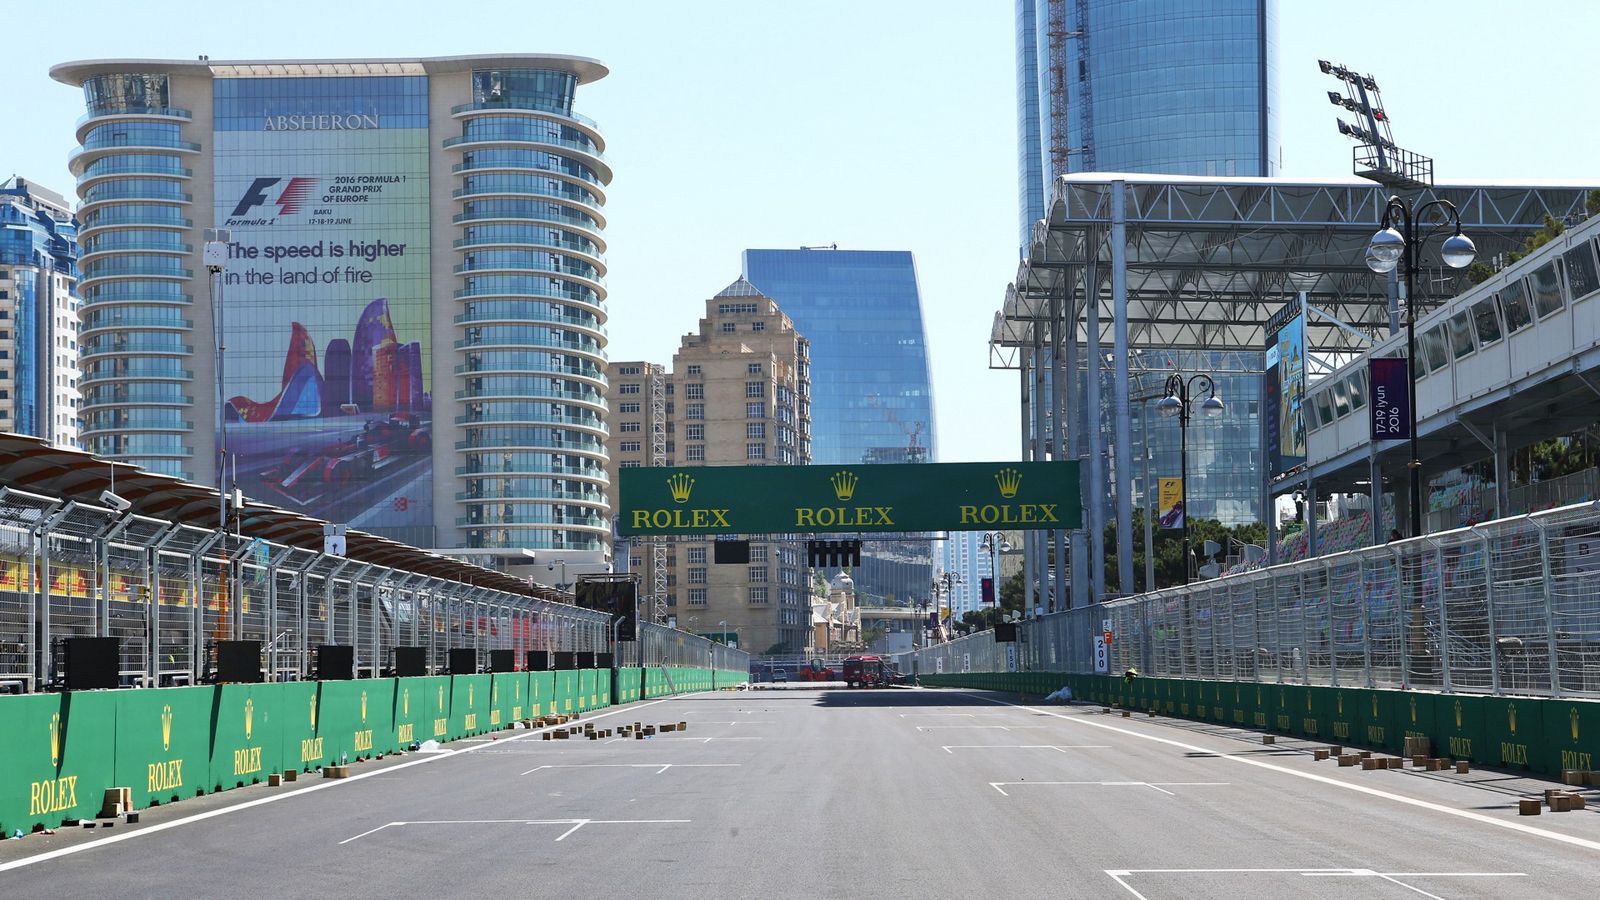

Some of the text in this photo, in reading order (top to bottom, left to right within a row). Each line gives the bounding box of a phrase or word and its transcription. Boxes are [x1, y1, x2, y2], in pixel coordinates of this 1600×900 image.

[264, 114, 379, 131] ABSHERON
[329, 185, 382, 193] GRAND PRIX
[335, 176, 355, 184] 2016
[357, 175, 400, 183] FORMULA
[322, 195, 335, 203] OF
[225, 217, 267, 226] Formula
[227, 239, 407, 263] The speed is higher
[225, 266, 373, 285] in the land of fire
[1376, 410, 1386, 434] 17-19
[1389, 407, 1400, 433] 2016
[632, 508, 730, 529] ROLEX
[795, 506, 895, 526] ROLEX
[959, 503, 1060, 524] ROLEX
[354, 729, 373, 751] ROLEX
[1367, 725, 1385, 743] ROLEX
[302, 737, 323, 762] ROLEX
[1449, 736, 1472, 757] ROLEX
[1501, 742, 1529, 765] ROLEX
[234, 747, 262, 775] ROLEX
[1561, 750, 1592, 771] ROLEX
[147, 759, 183, 792] ROLEX
[29, 776, 78, 816] ROLEX
